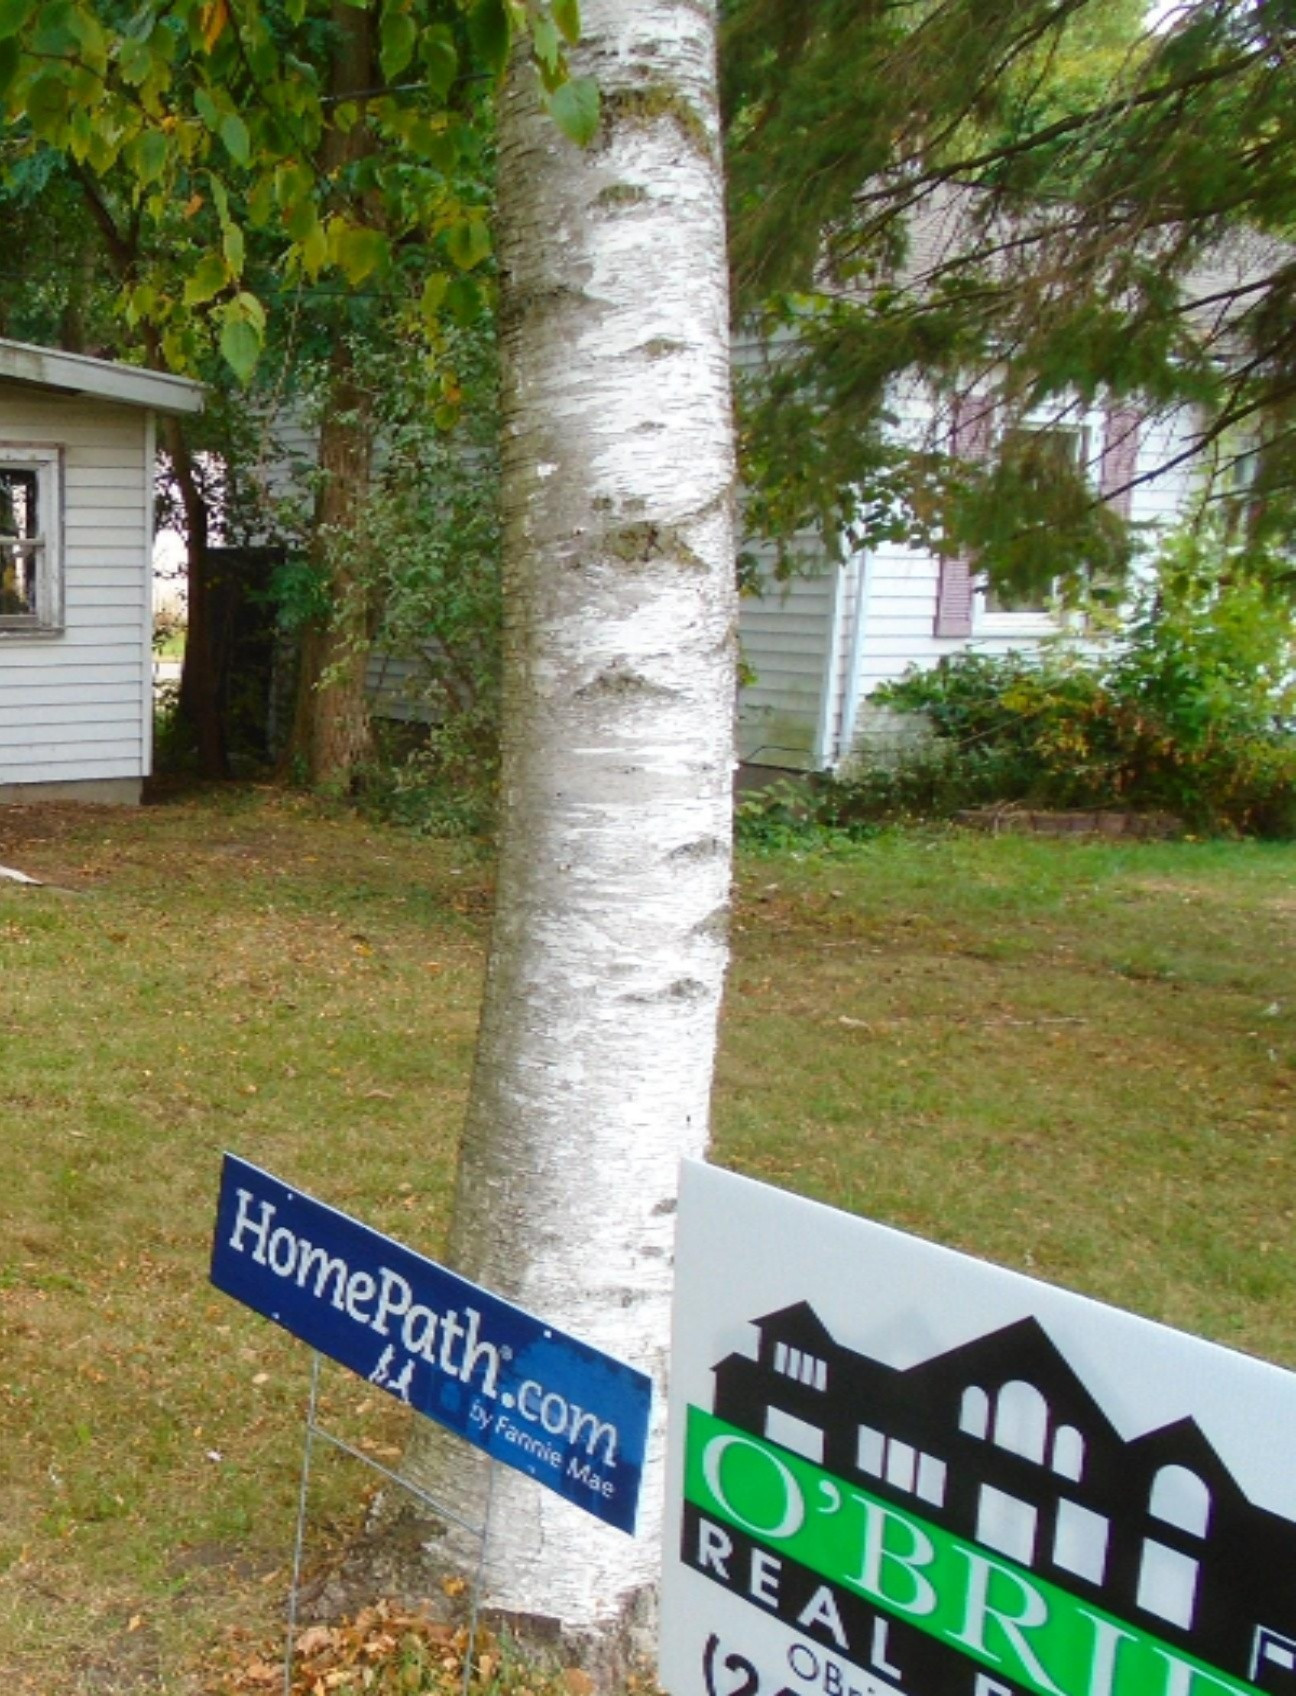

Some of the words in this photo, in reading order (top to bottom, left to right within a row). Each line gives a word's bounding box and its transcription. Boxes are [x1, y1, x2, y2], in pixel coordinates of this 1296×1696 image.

[469, 1398, 494, 1430] by
[494, 1415, 562, 1468] Fannie
[566, 1457, 615, 1499] Mae
[698, 1517, 903, 1681] REAL
